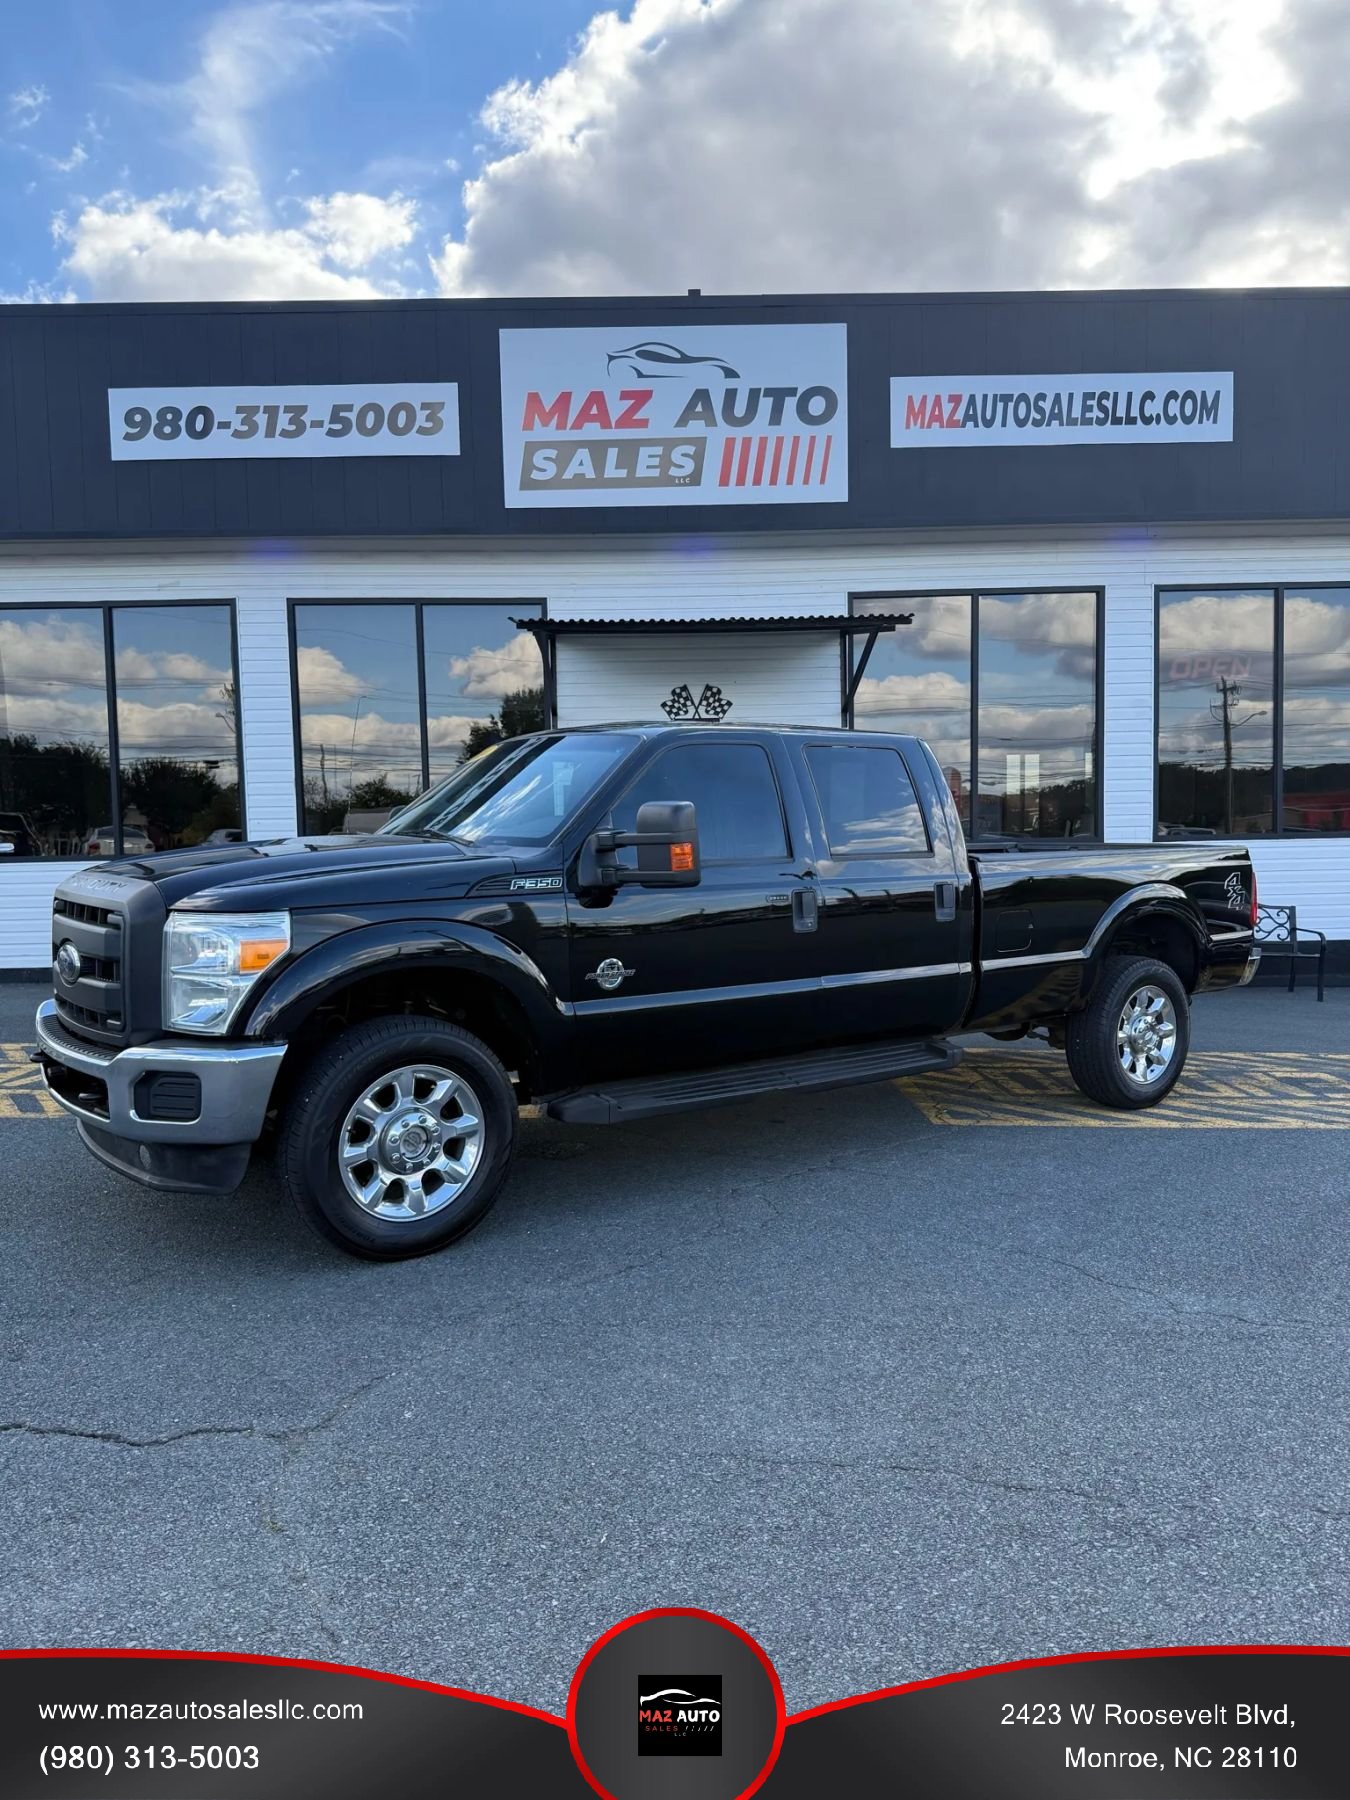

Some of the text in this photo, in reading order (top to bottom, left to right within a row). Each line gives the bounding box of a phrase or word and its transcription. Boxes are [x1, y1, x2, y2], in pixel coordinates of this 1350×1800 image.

[122, 401, 446, 442] 980-313-5003
[521, 385, 839, 432] MAZ AUTO
[904, 389, 1221, 430] MAZAUTOSALESLLC.COM
[529, 444, 697, 481] SALES
[1169, 656, 1252, 679] OPEN
